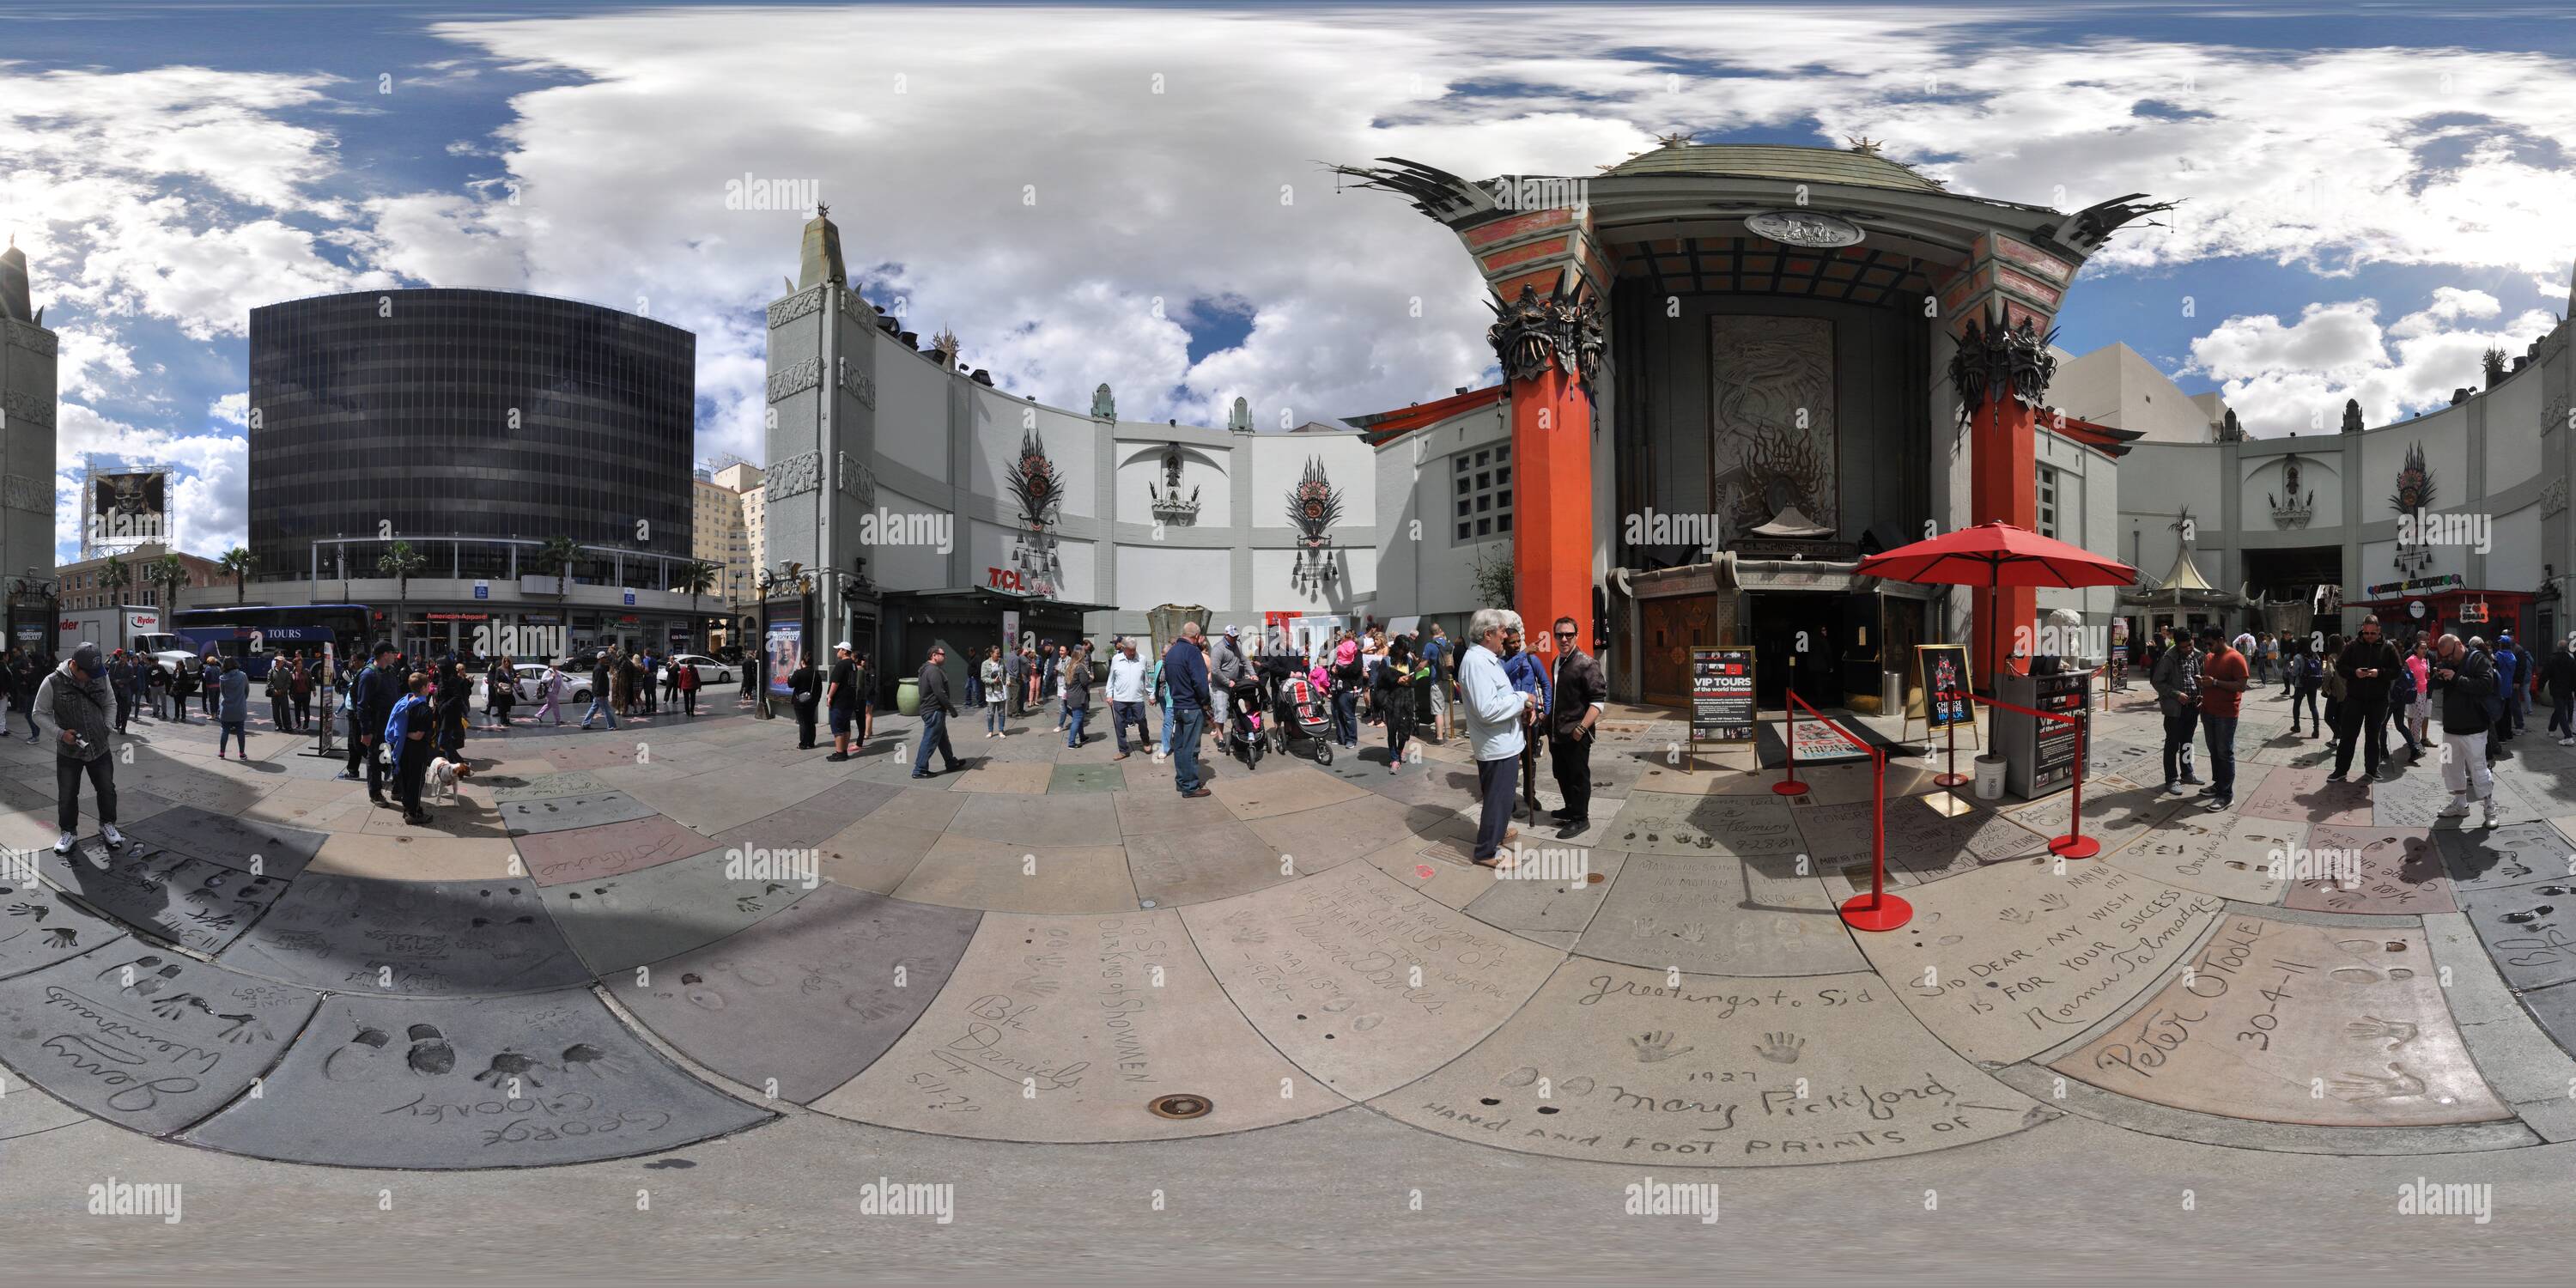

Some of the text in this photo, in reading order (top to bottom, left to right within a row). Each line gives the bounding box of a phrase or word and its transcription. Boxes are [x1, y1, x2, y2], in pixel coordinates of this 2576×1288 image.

[988, 567, 1025, 592] TCL
[137, 616, 156, 625] Ryder
[268, 629, 301, 639] TOURS
[1694, 677, 1752, 687] VIP TOURS
[1923, 864, 1951, 878] FOR
[2105, 873, 2129, 890] 1927
[1295, 883, 1506, 999] THE THEATRE FROM YOUR PAL
[1329, 886, 1506, 971] THE GENIUS OF
[1400, 901, 1513, 958] Grauman
[1968, 949, 2034, 978] DEAR
[2047, 925, 2083, 948] MY
[2088, 893, 2135, 922] WISH
[1275, 948, 1307, 975] MAY
[1970, 888, 2182, 1015] IS FOR YOUR SUCCESS
[1767, 989, 1801, 1008] to
[1818, 987, 1874, 1006] Sid
[2023, 970, 2122, 1030] Norma
[2236, 957, 2318, 1052] 30-4-11
[45, 986, 221, 1074] Weintraub
[42, 1035, 199, 1111] Jerry
[1688, 1071, 1757, 1083] 1927
[1760, 1072, 1957, 1121] Pickford
[1625, 1138, 1716, 1155] FOOT
[1930, 1116, 1976, 1133] OF
